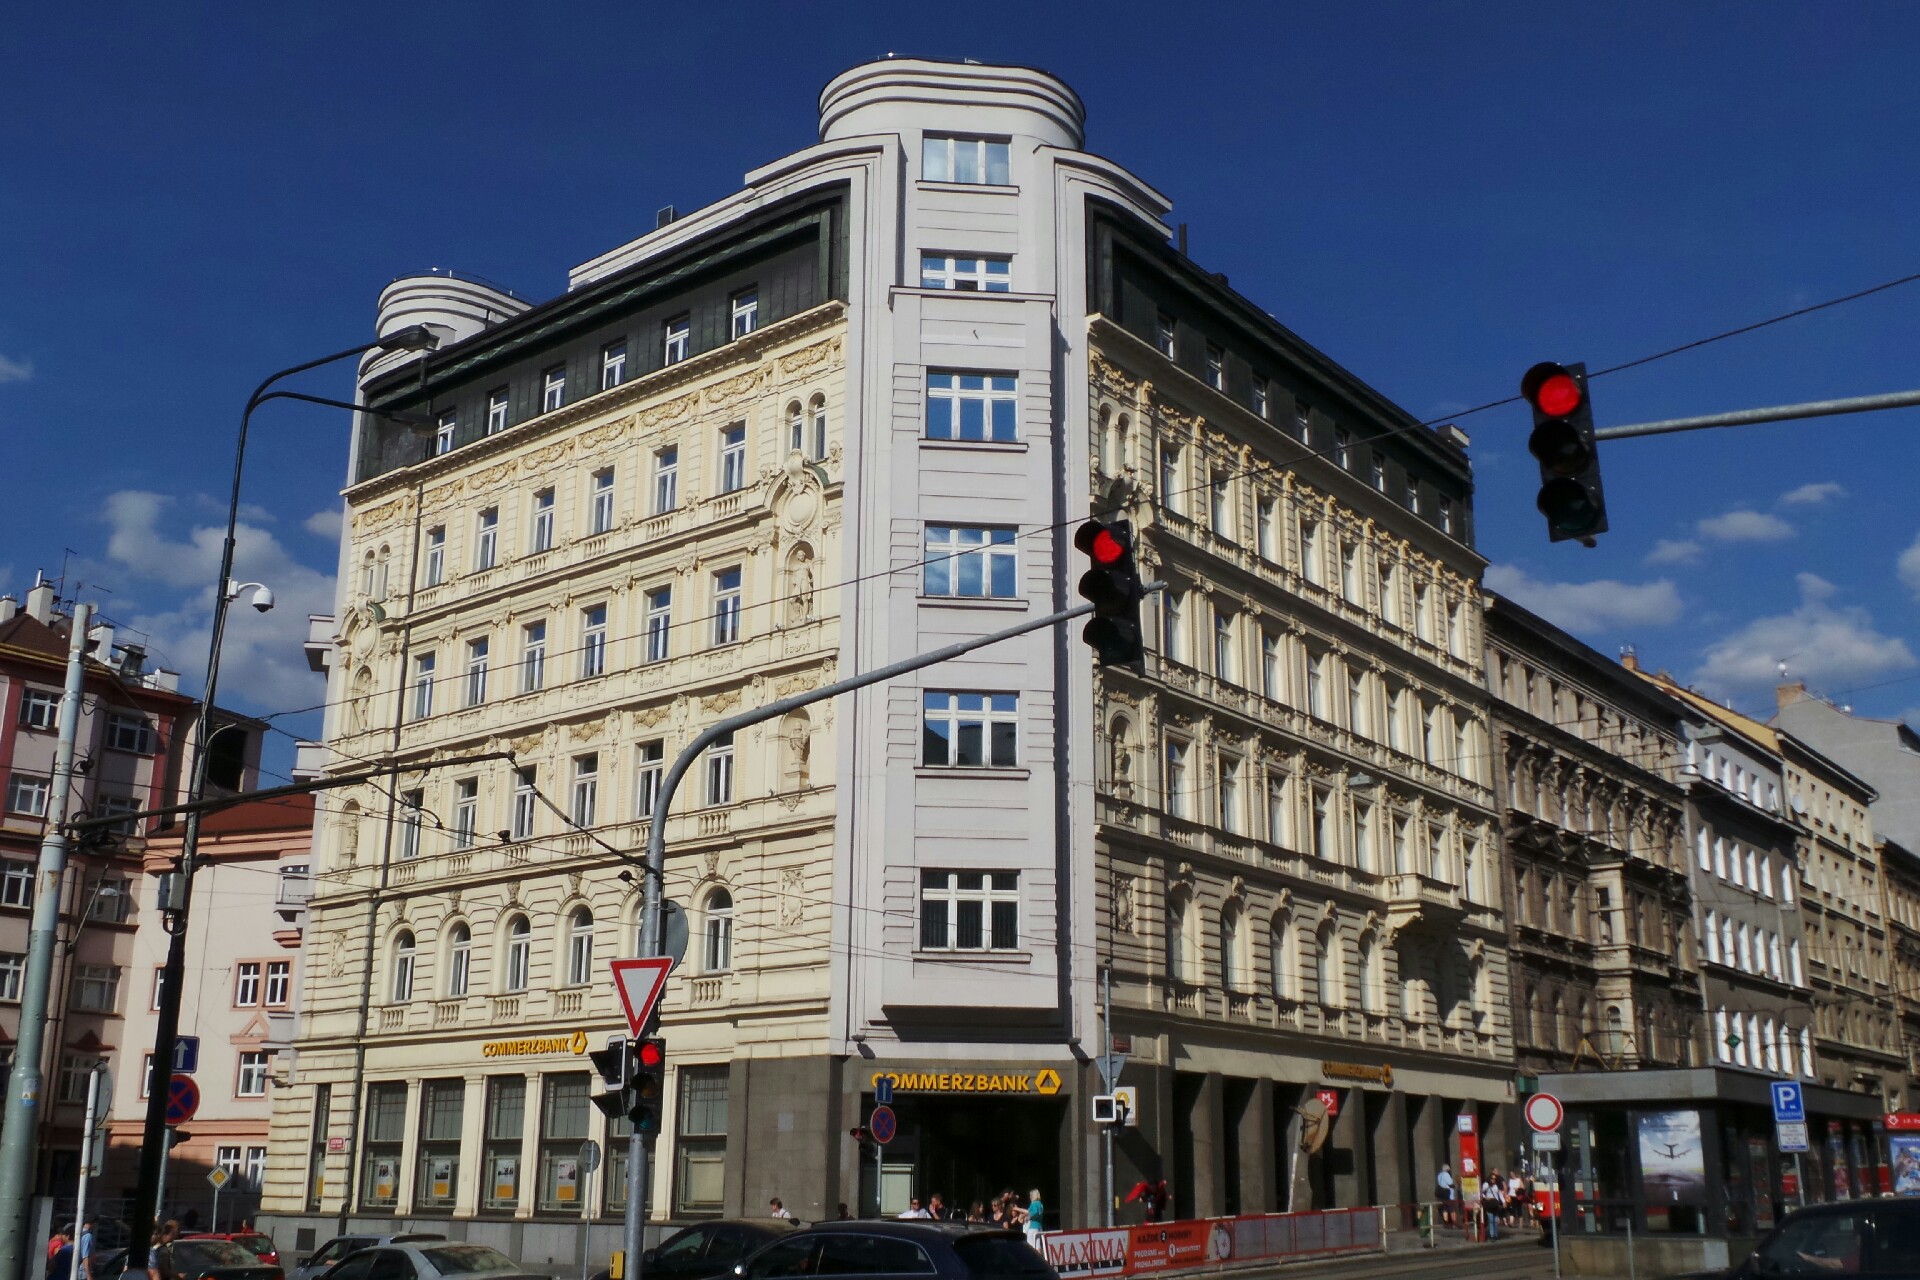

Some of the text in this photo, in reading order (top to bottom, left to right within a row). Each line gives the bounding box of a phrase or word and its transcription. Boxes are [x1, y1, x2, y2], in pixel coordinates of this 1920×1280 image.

[483, 1038, 569, 1057] COMMERZBANK
[871, 1072, 1030, 1093] COMMERZBANK
[1778, 1087, 1796, 1110] P
[1049, 1237, 1127, 1265] MAXIMA
